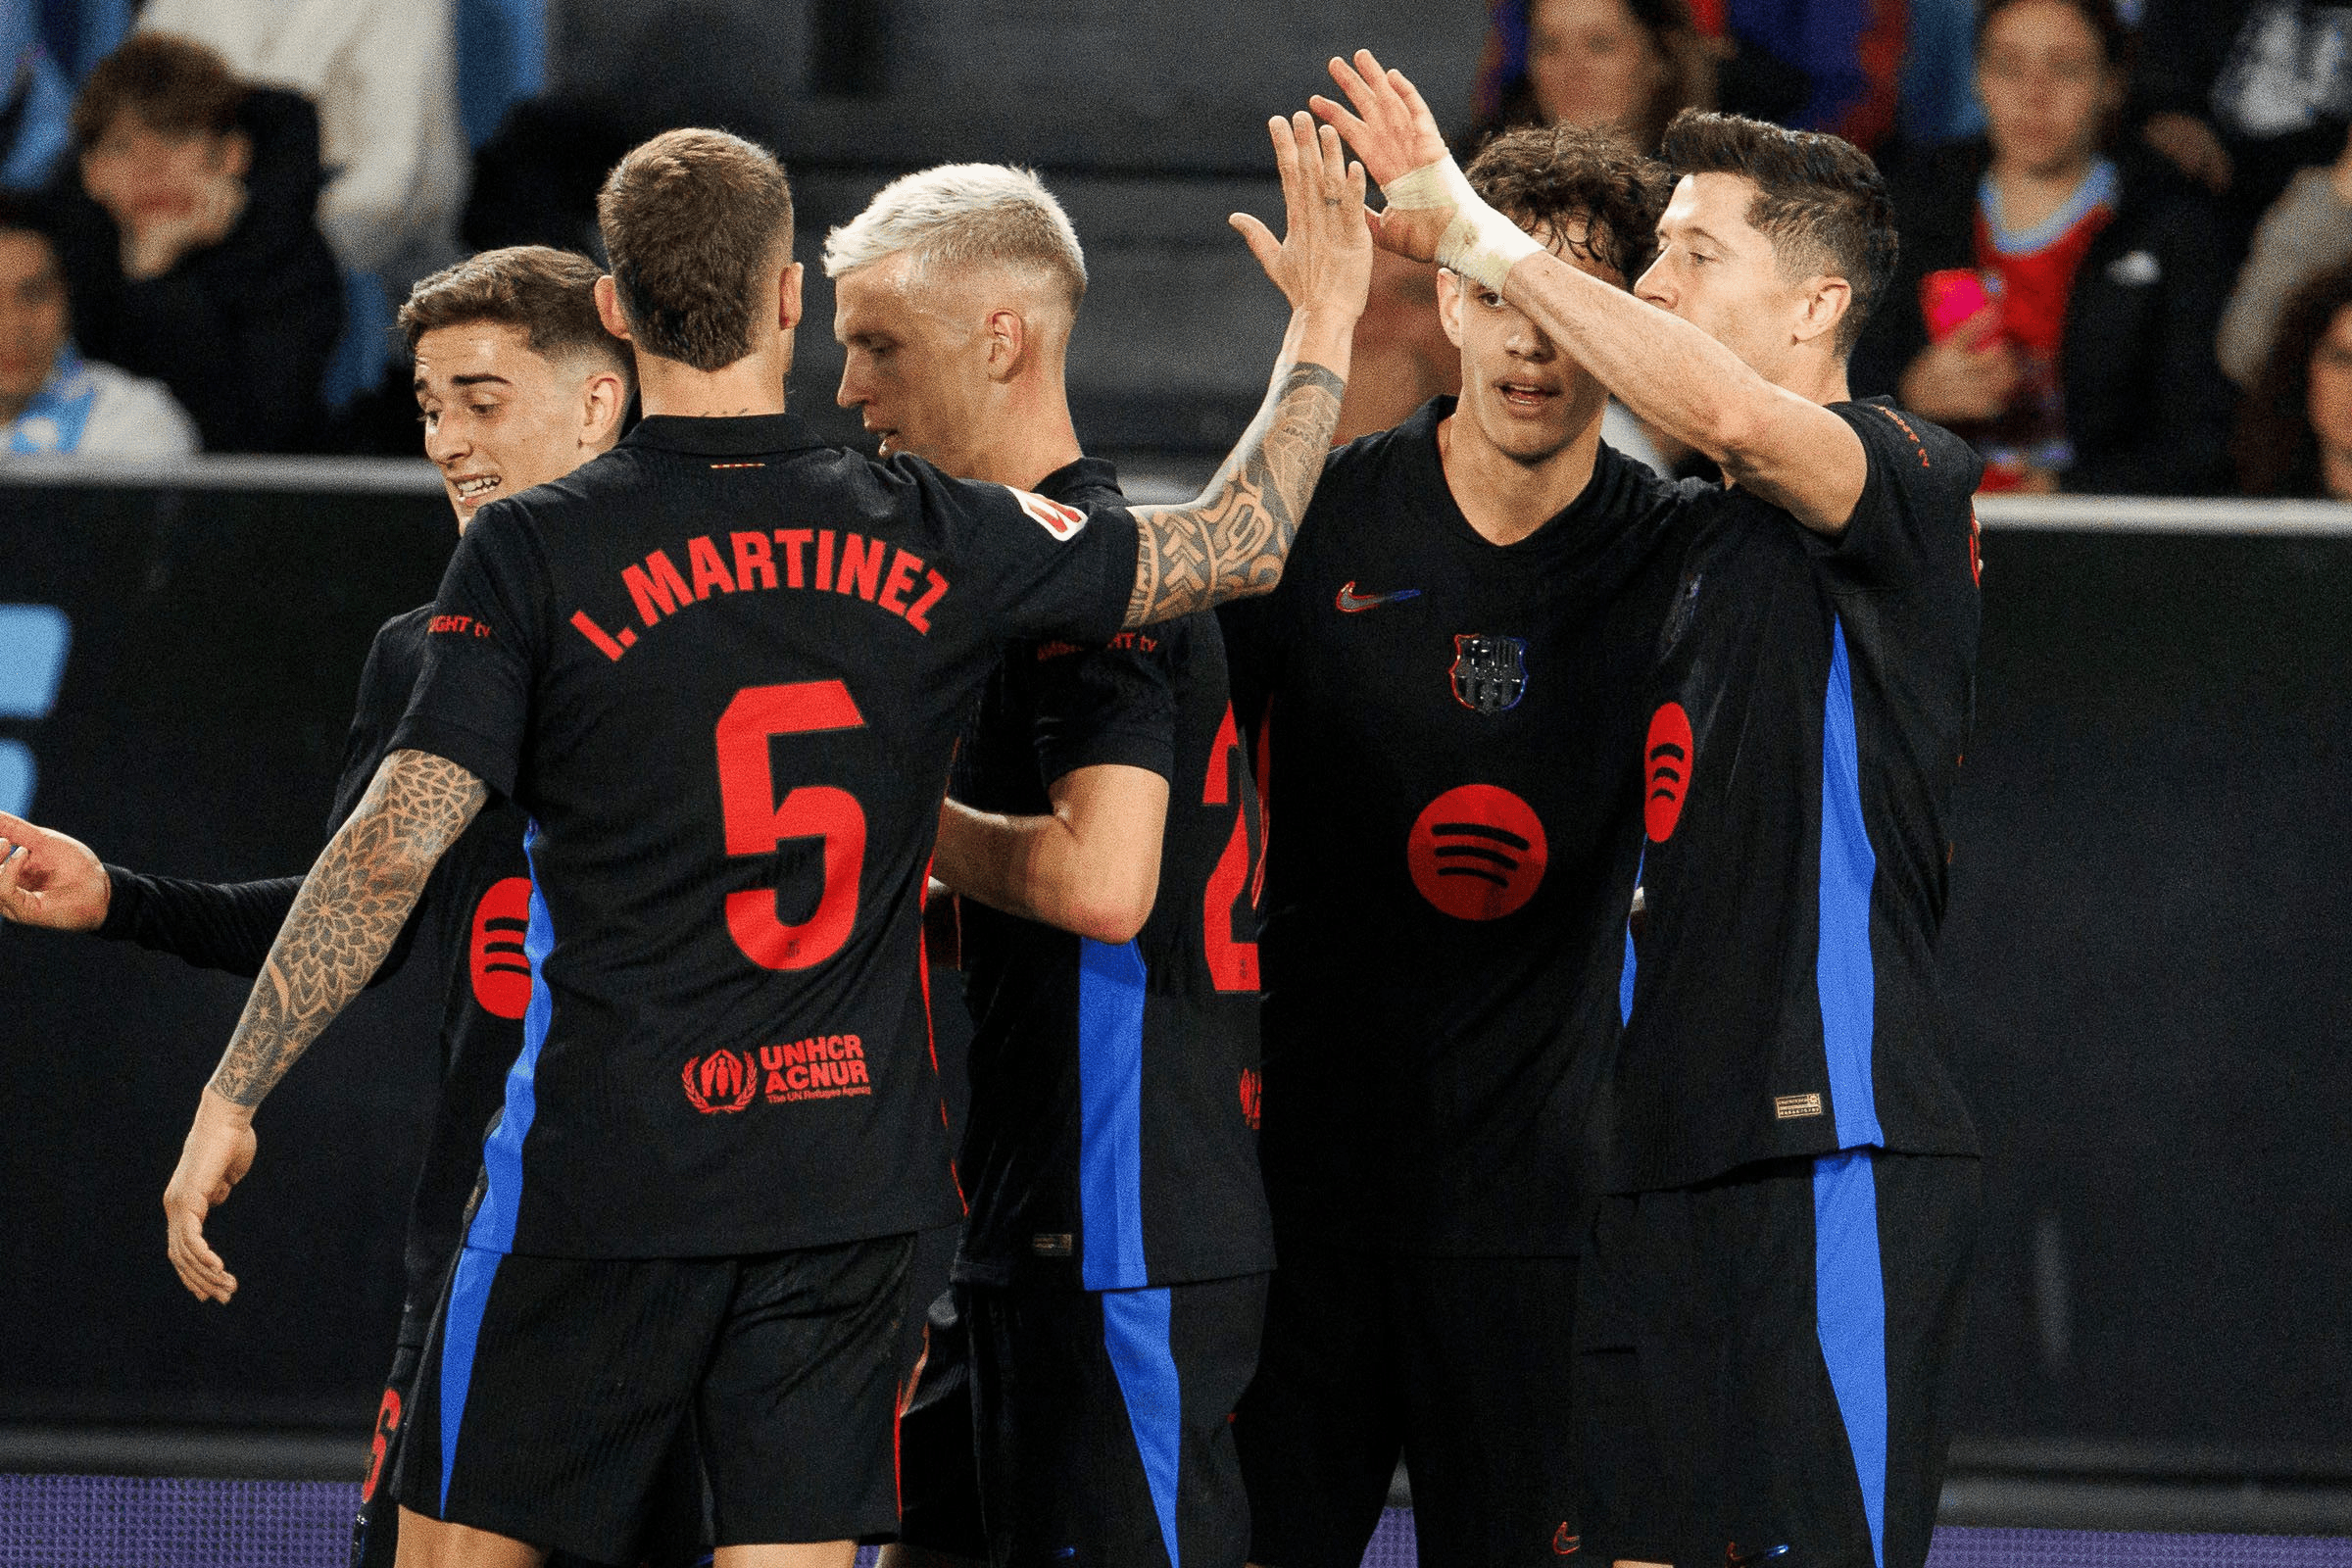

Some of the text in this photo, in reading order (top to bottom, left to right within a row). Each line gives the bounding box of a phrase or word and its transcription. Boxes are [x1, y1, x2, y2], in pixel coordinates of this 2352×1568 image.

[570, 528, 950, 662] I. MARTINEZ
[715, 679, 867, 971] 5
[760, 1034, 864, 1070] UNHCR
[764, 1059, 869, 1093] ACNUR
